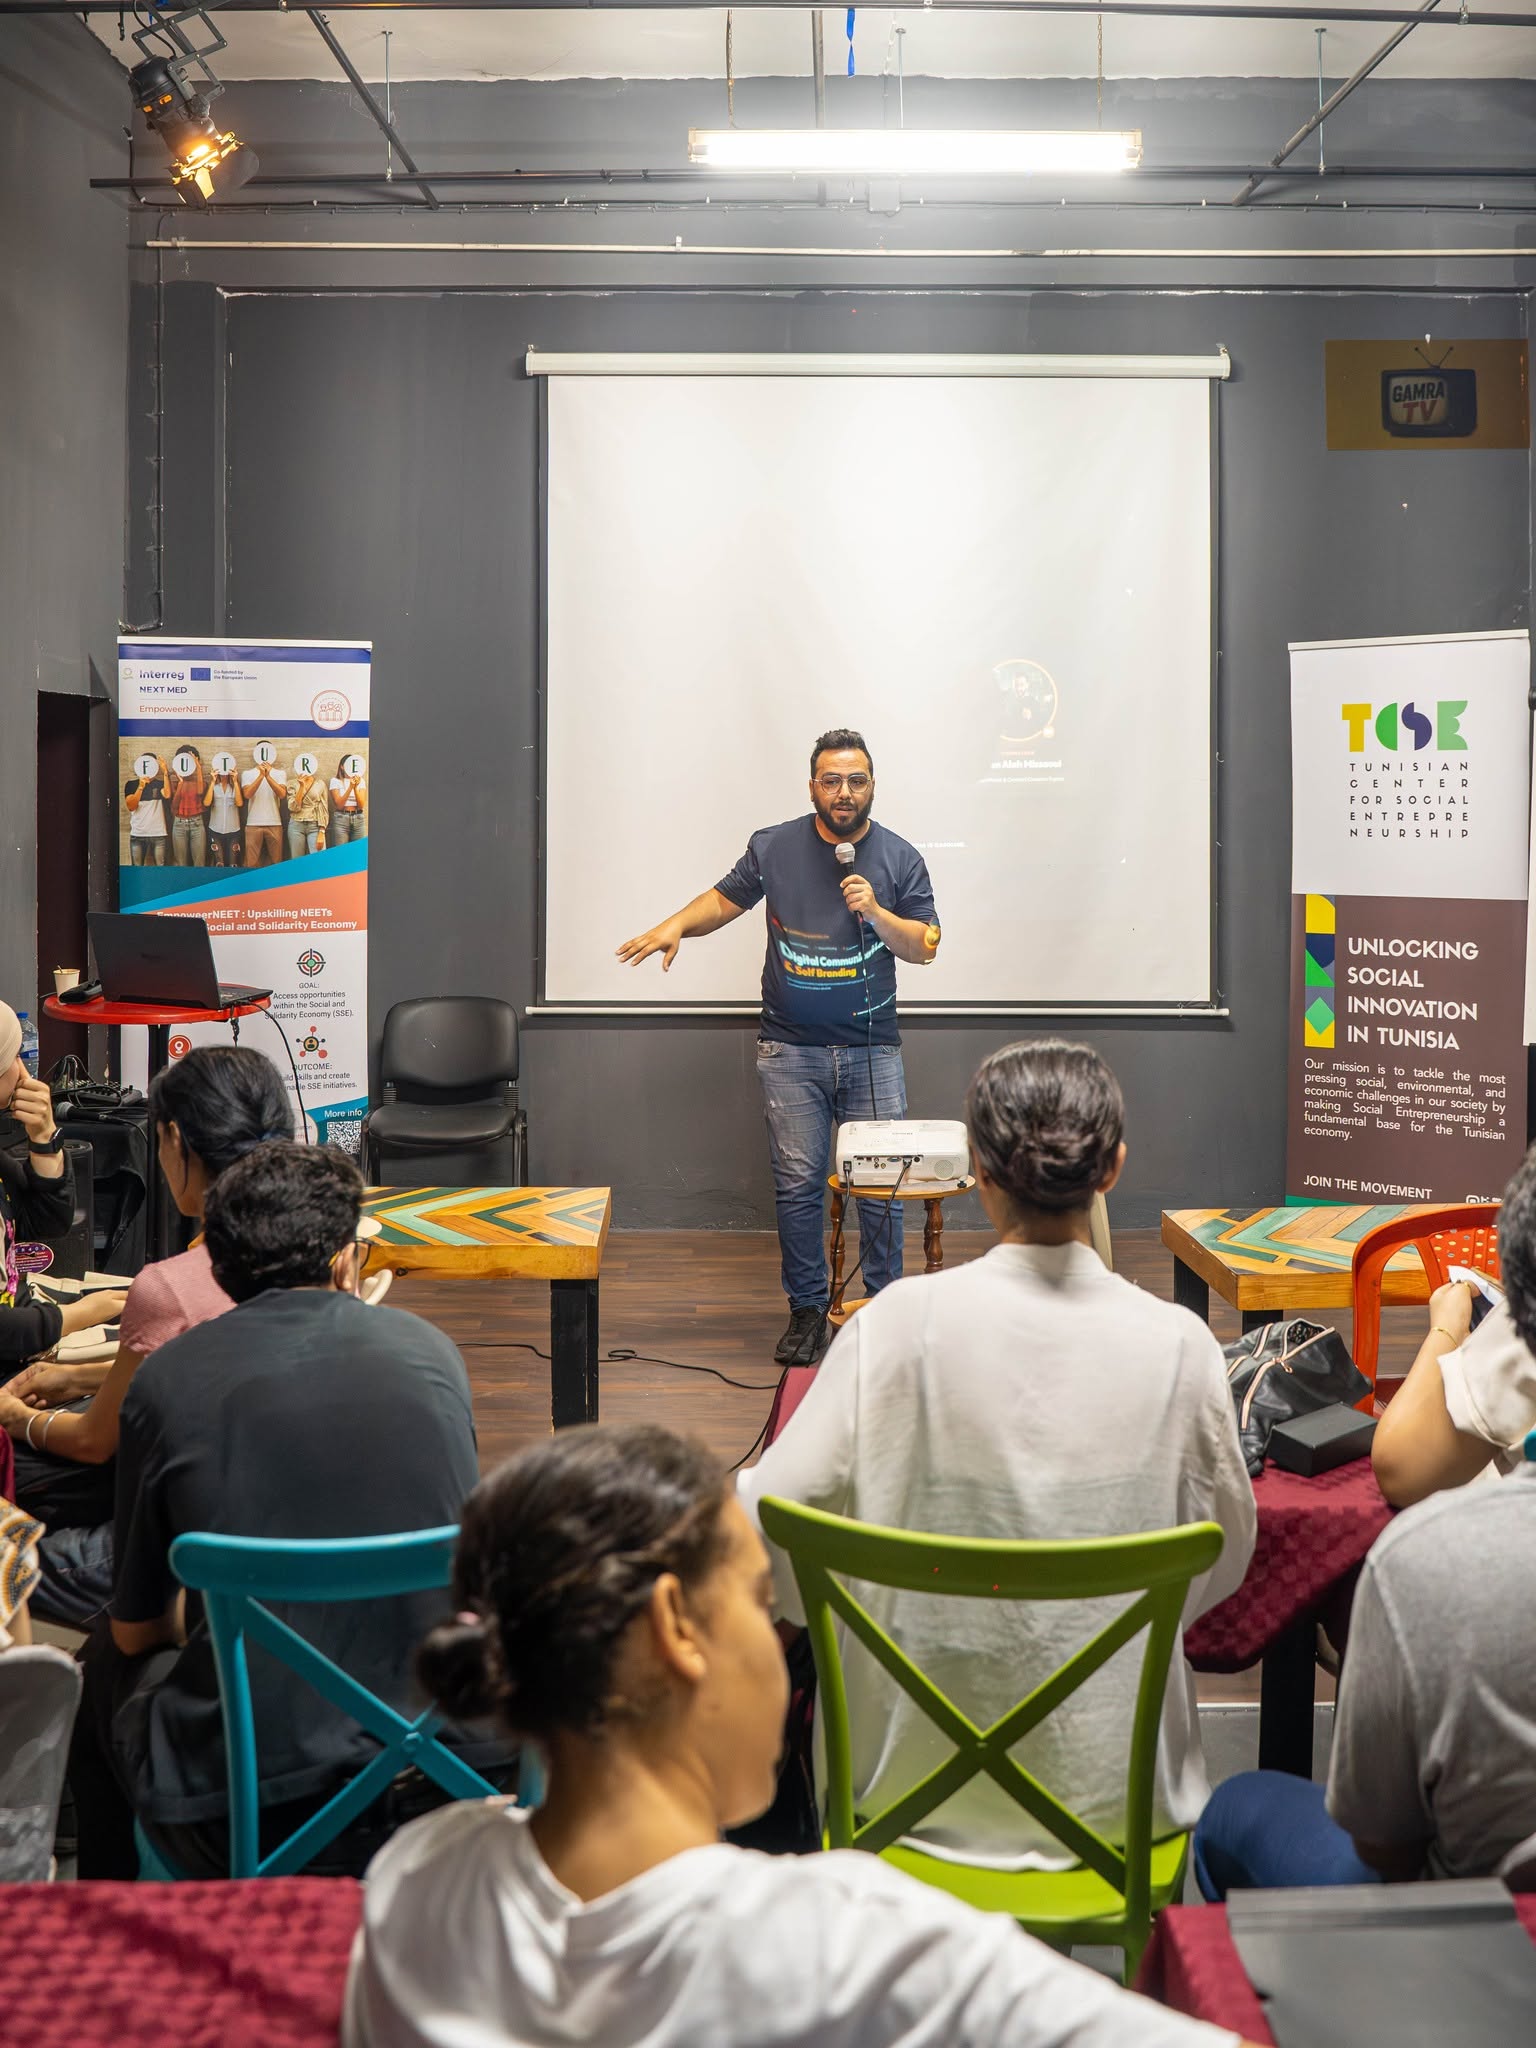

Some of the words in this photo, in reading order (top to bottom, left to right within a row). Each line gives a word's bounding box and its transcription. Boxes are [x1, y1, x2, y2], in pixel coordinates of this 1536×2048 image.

[1392, 381, 1445, 403] GAMRA
[1402, 399, 1437, 423] TV
[167, 686, 188, 694] MED
[139, 705, 209, 713] EmpoweerNEET
[1350, 762, 1468, 772] TUNISIAN
[1350, 779, 1468, 789] CENTER
[1350, 795, 1382, 805] FOR
[1396, 795, 1468, 805] SOCIAL
[1350, 812, 1468, 821] ENTREPRE
[1350, 828, 1468, 838] NEURSHIP
[247, 909, 298, 920] Upskilling
[300, 908, 333, 917] NEETs
[236, 922, 256, 930] and
[258, 921, 309, 931] Solidarity
[310, 921, 357, 930] Economy
[779, 940, 820, 967] Digital
[1348, 937, 1479, 960] UNLOCKING
[816, 967, 857, 978] Branding
[1347, 966, 1424, 988] SOCIAL
[299, 990, 346, 999] opportunities
[273, 1001, 294, 1009] within
[1347, 995, 1478, 1021] INNOVATION
[299, 1011, 332, 1019] Economy
[1347, 1025, 1369, 1043] IN
[1377, 1027, 1460, 1050] TUNISIA
[1304, 1058, 1325, 1069] Our
[1332, 1061, 1370, 1073] mission
[1377, 1064, 1386, 1075] is
[1393, 1066, 1405, 1076] to
[1413, 1068, 1445, 1079] tackle
[1452, 1070, 1471, 1081] the
[1479, 1074, 1506, 1084] most
[307, 1082, 322, 1090] SSE
[1304, 1073, 1346, 1087] pressing
[1355, 1077, 1387, 1090] social,
[1397, 1081, 1474, 1097] environmental,
[1485, 1087, 1506, 1098] and
[1304, 1087, 1354, 1099] economic
[1356, 1089, 1411, 1105] challenges
[1414, 1094, 1424, 1105] in
[1428, 1098, 1447, 1107] our
[1450, 1099, 1488, 1113] society
[1492, 1100, 1506, 1115] by
[324, 1110, 346, 1118] More
[347, 1109, 363, 1117] info
[1304, 1099, 1341, 1113] making
[1353, 1102, 1383, 1115] Social
[1395, 1106, 1486, 1127] Entrepreneurship
[1498, 1118, 1506, 1127] a
[1304, 1110, 1367, 1127] fundamental
[1376, 1117, 1401, 1130] base
[1410, 1120, 1426, 1132] for
[1435, 1123, 1453, 1135] the
[1462, 1125, 1505, 1141] Tunisian
[1304, 1126, 1353, 1141] economy.
[1303, 1175, 1332, 1188] JOIN
[1334, 1178, 1358, 1191] THE
[1360, 1181, 1433, 1200] MOVEMENT
